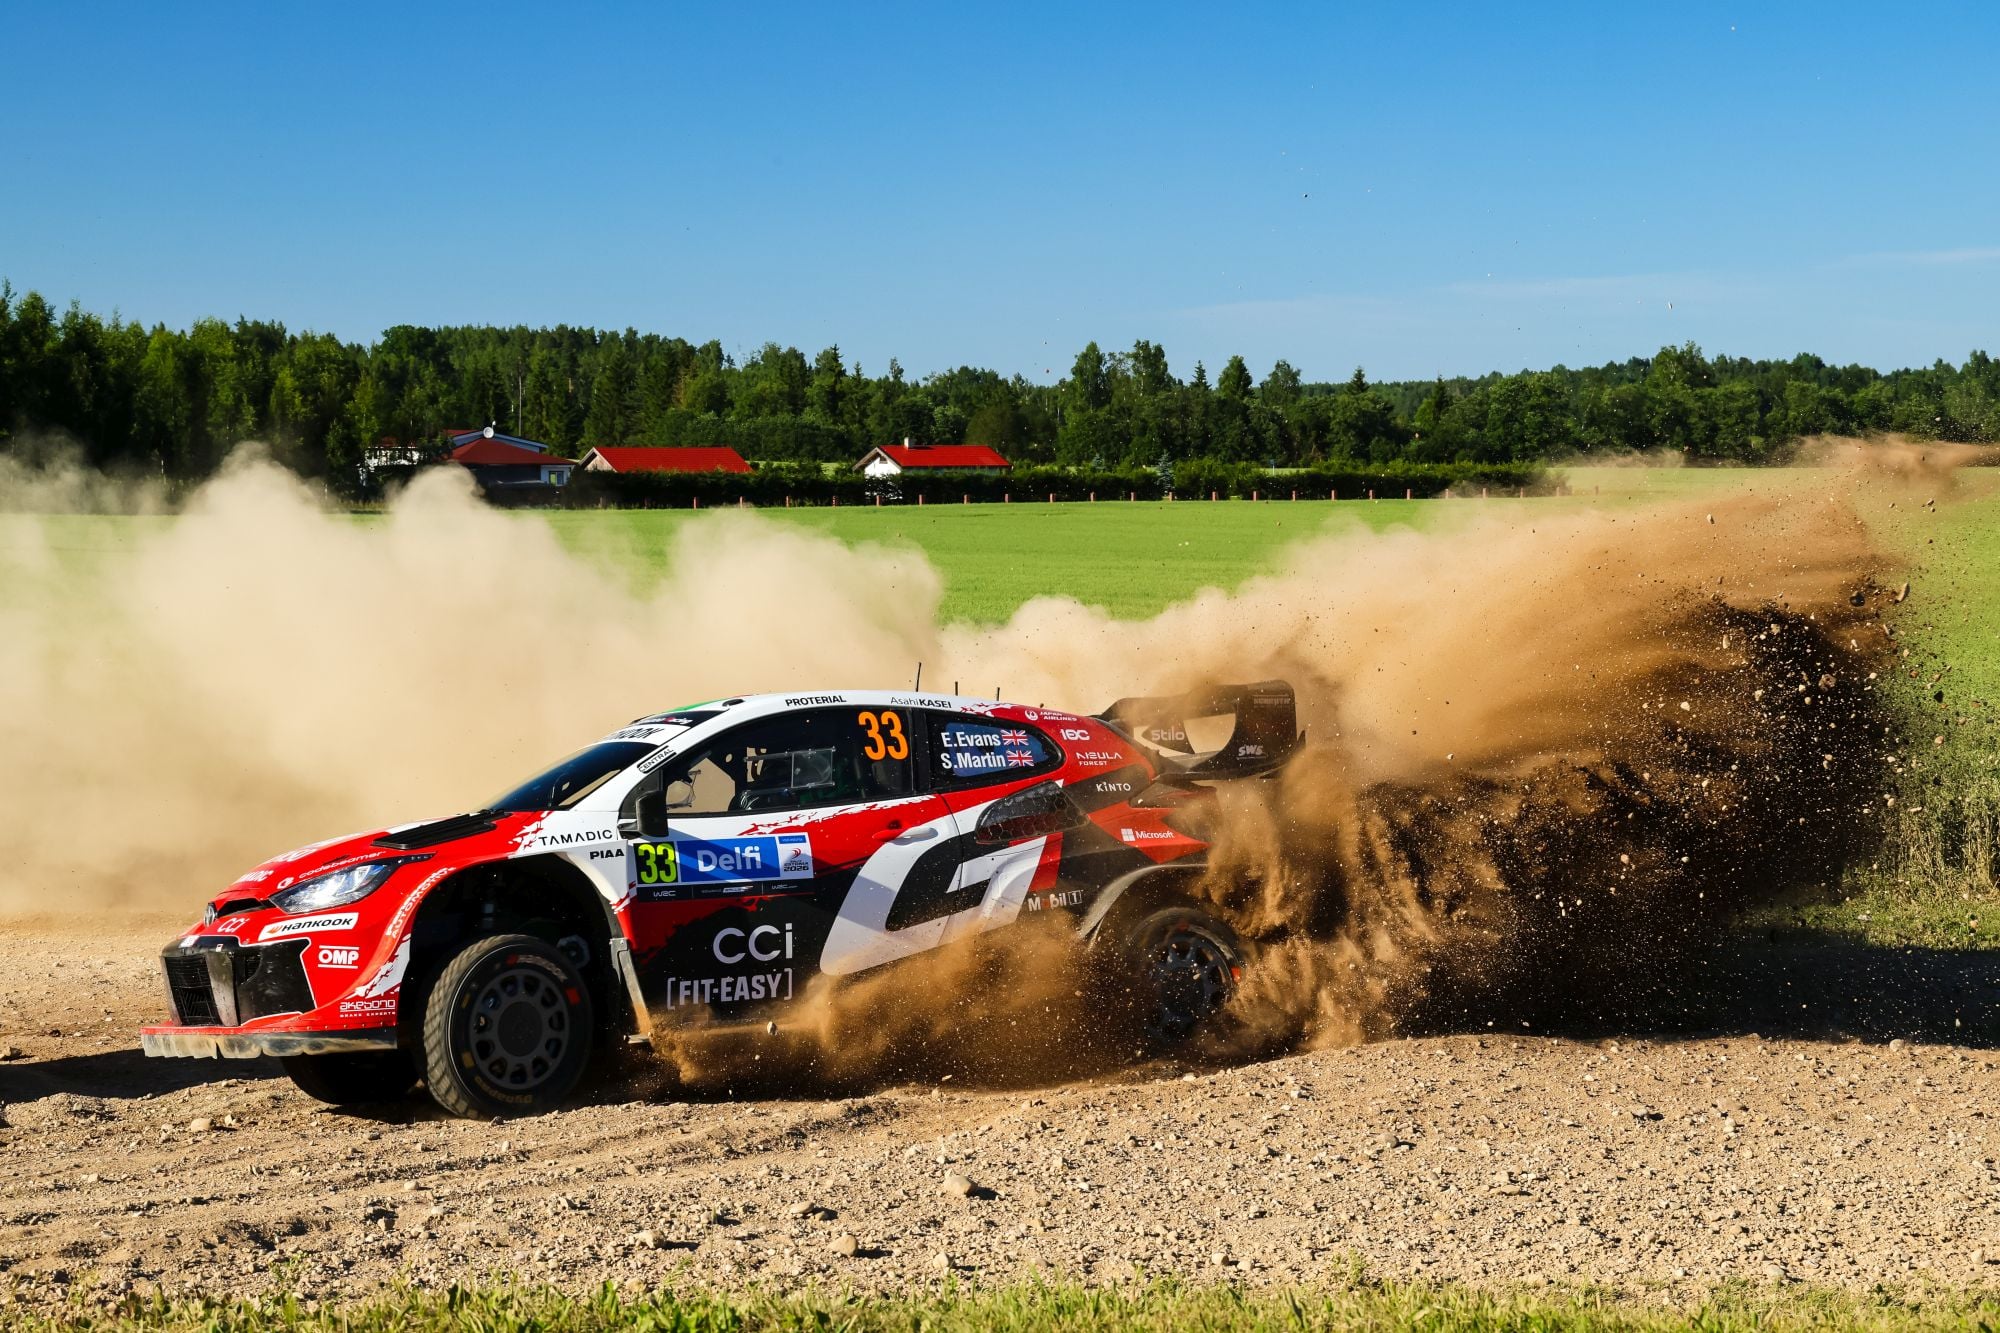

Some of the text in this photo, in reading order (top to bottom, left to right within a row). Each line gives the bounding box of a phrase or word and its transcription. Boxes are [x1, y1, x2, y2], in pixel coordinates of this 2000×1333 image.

[784, 695, 847, 707] PROTERIAL
[858, 711, 909, 760] 33
[940, 731, 1002, 748] E.Evans
[1151, 726, 1185, 741] Stilo
[940, 751, 1006, 769] S.Martin
[539, 829, 613, 846] TAMADIC
[1135, 830, 1175, 839] Microsoft
[589, 848, 625, 860] PIAA
[697, 846, 762, 872] Delfi
[638, 843, 677, 884] 33
[1028, 892, 1067, 912] Mobil
[318, 949, 360, 965] OMP
